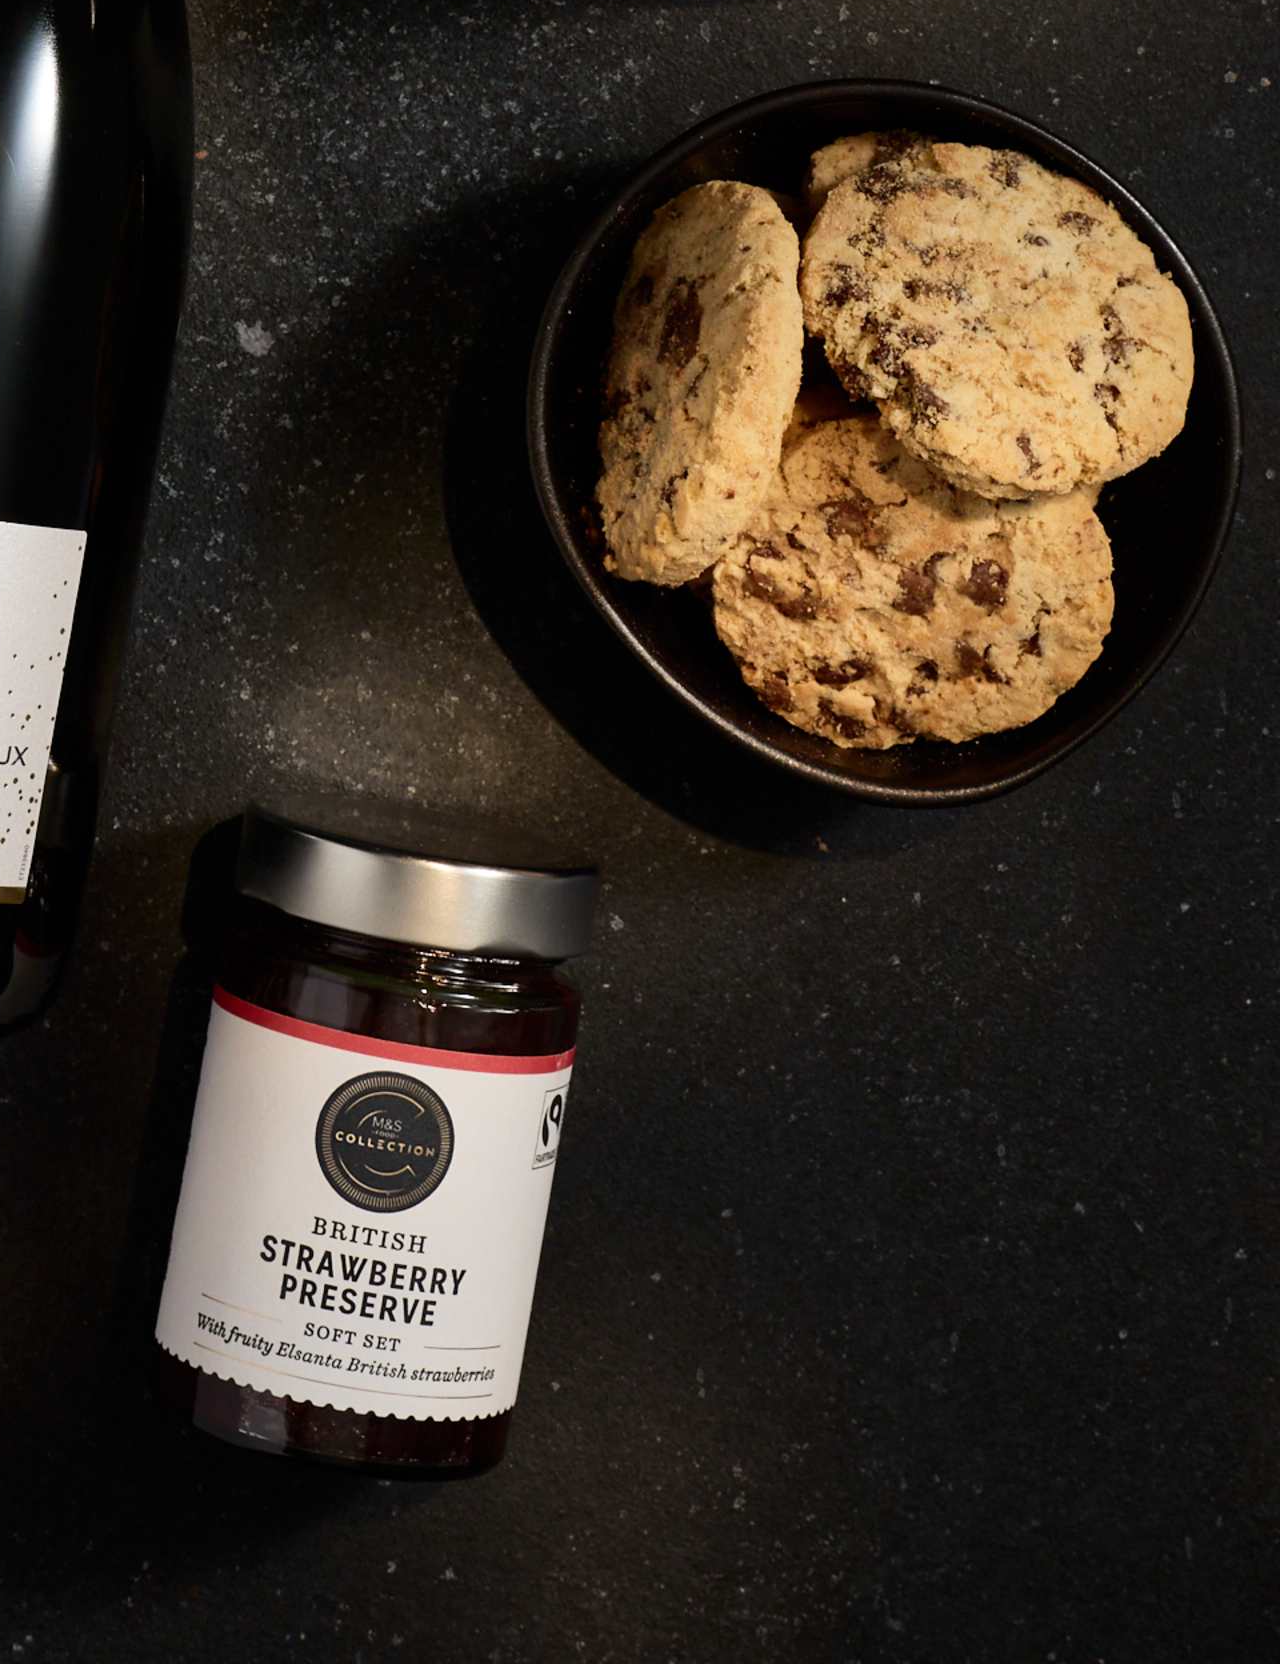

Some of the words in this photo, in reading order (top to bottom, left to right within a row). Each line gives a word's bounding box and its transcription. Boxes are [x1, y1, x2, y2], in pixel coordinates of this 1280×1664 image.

[334, 1130, 436, 1157] COLLECTION
[372, 1115, 403, 1133] M&S
[311, 1215, 428, 1254] BRITISH
[259, 1234, 467, 1296] STRAWBERRY
[279, 1273, 438, 1327] PRESERVE
[197, 1311, 227, 1338] With
[223, 1325, 274, 1357] fruity
[275, 1341, 343, 1370] Elsanta
[345, 1356, 407, 1380] British
[410, 1365, 496, 1383] strawberries
[303, 1321, 357, 1345] SOFT
[362, 1334, 402, 1353] SET
